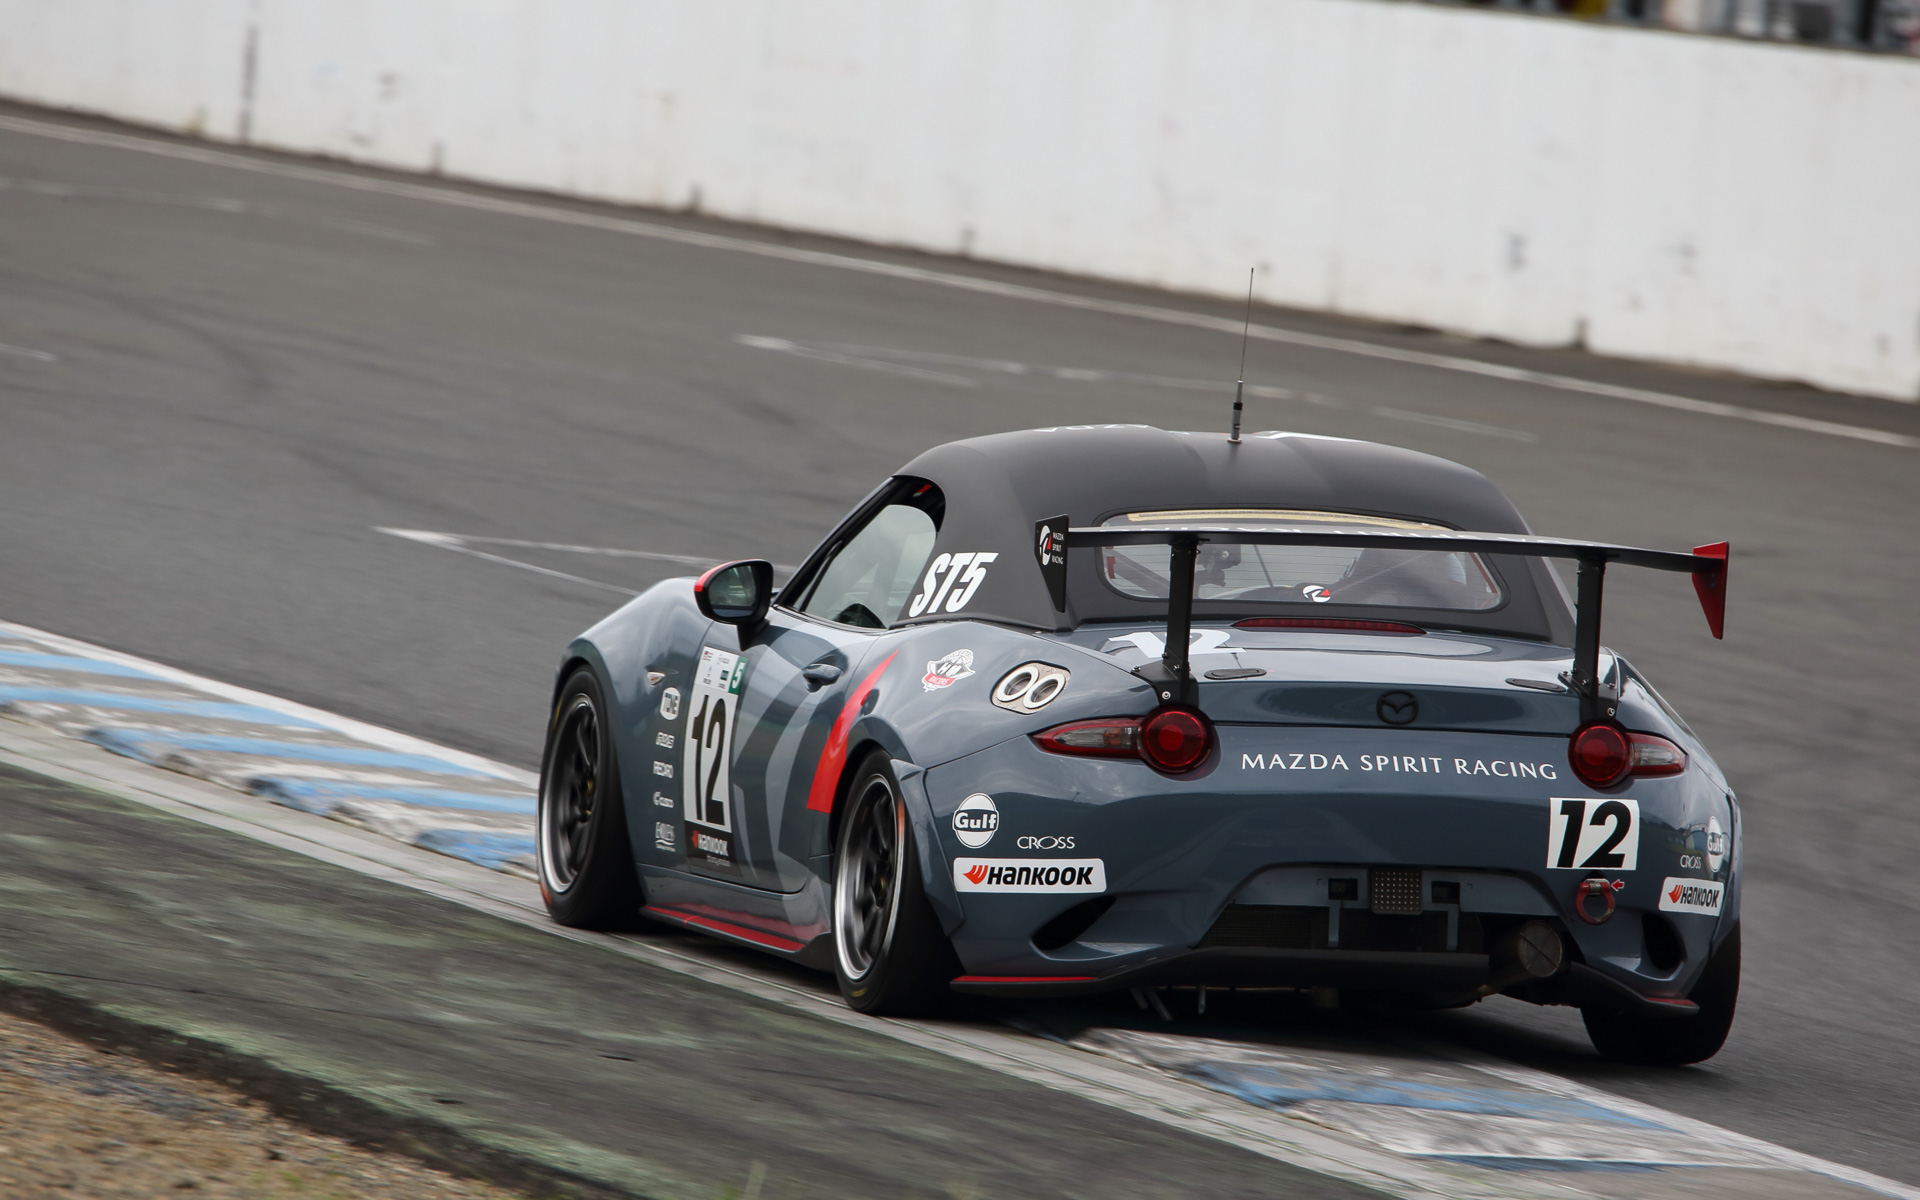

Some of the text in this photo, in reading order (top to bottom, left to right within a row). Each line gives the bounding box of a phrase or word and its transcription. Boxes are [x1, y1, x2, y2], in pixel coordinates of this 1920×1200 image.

[908, 552, 999, 618] ST5
[732, 662, 746, 689] 5
[691, 694, 726, 826] 12
[1241, 753, 1557, 780] MAZDA SPIRIT RACING
[955, 812, 997, 829] Gulf
[1557, 800, 1631, 868] 12
[1017, 836, 1075, 849] CROSS
[1680, 854, 1702, 869] CROSS
